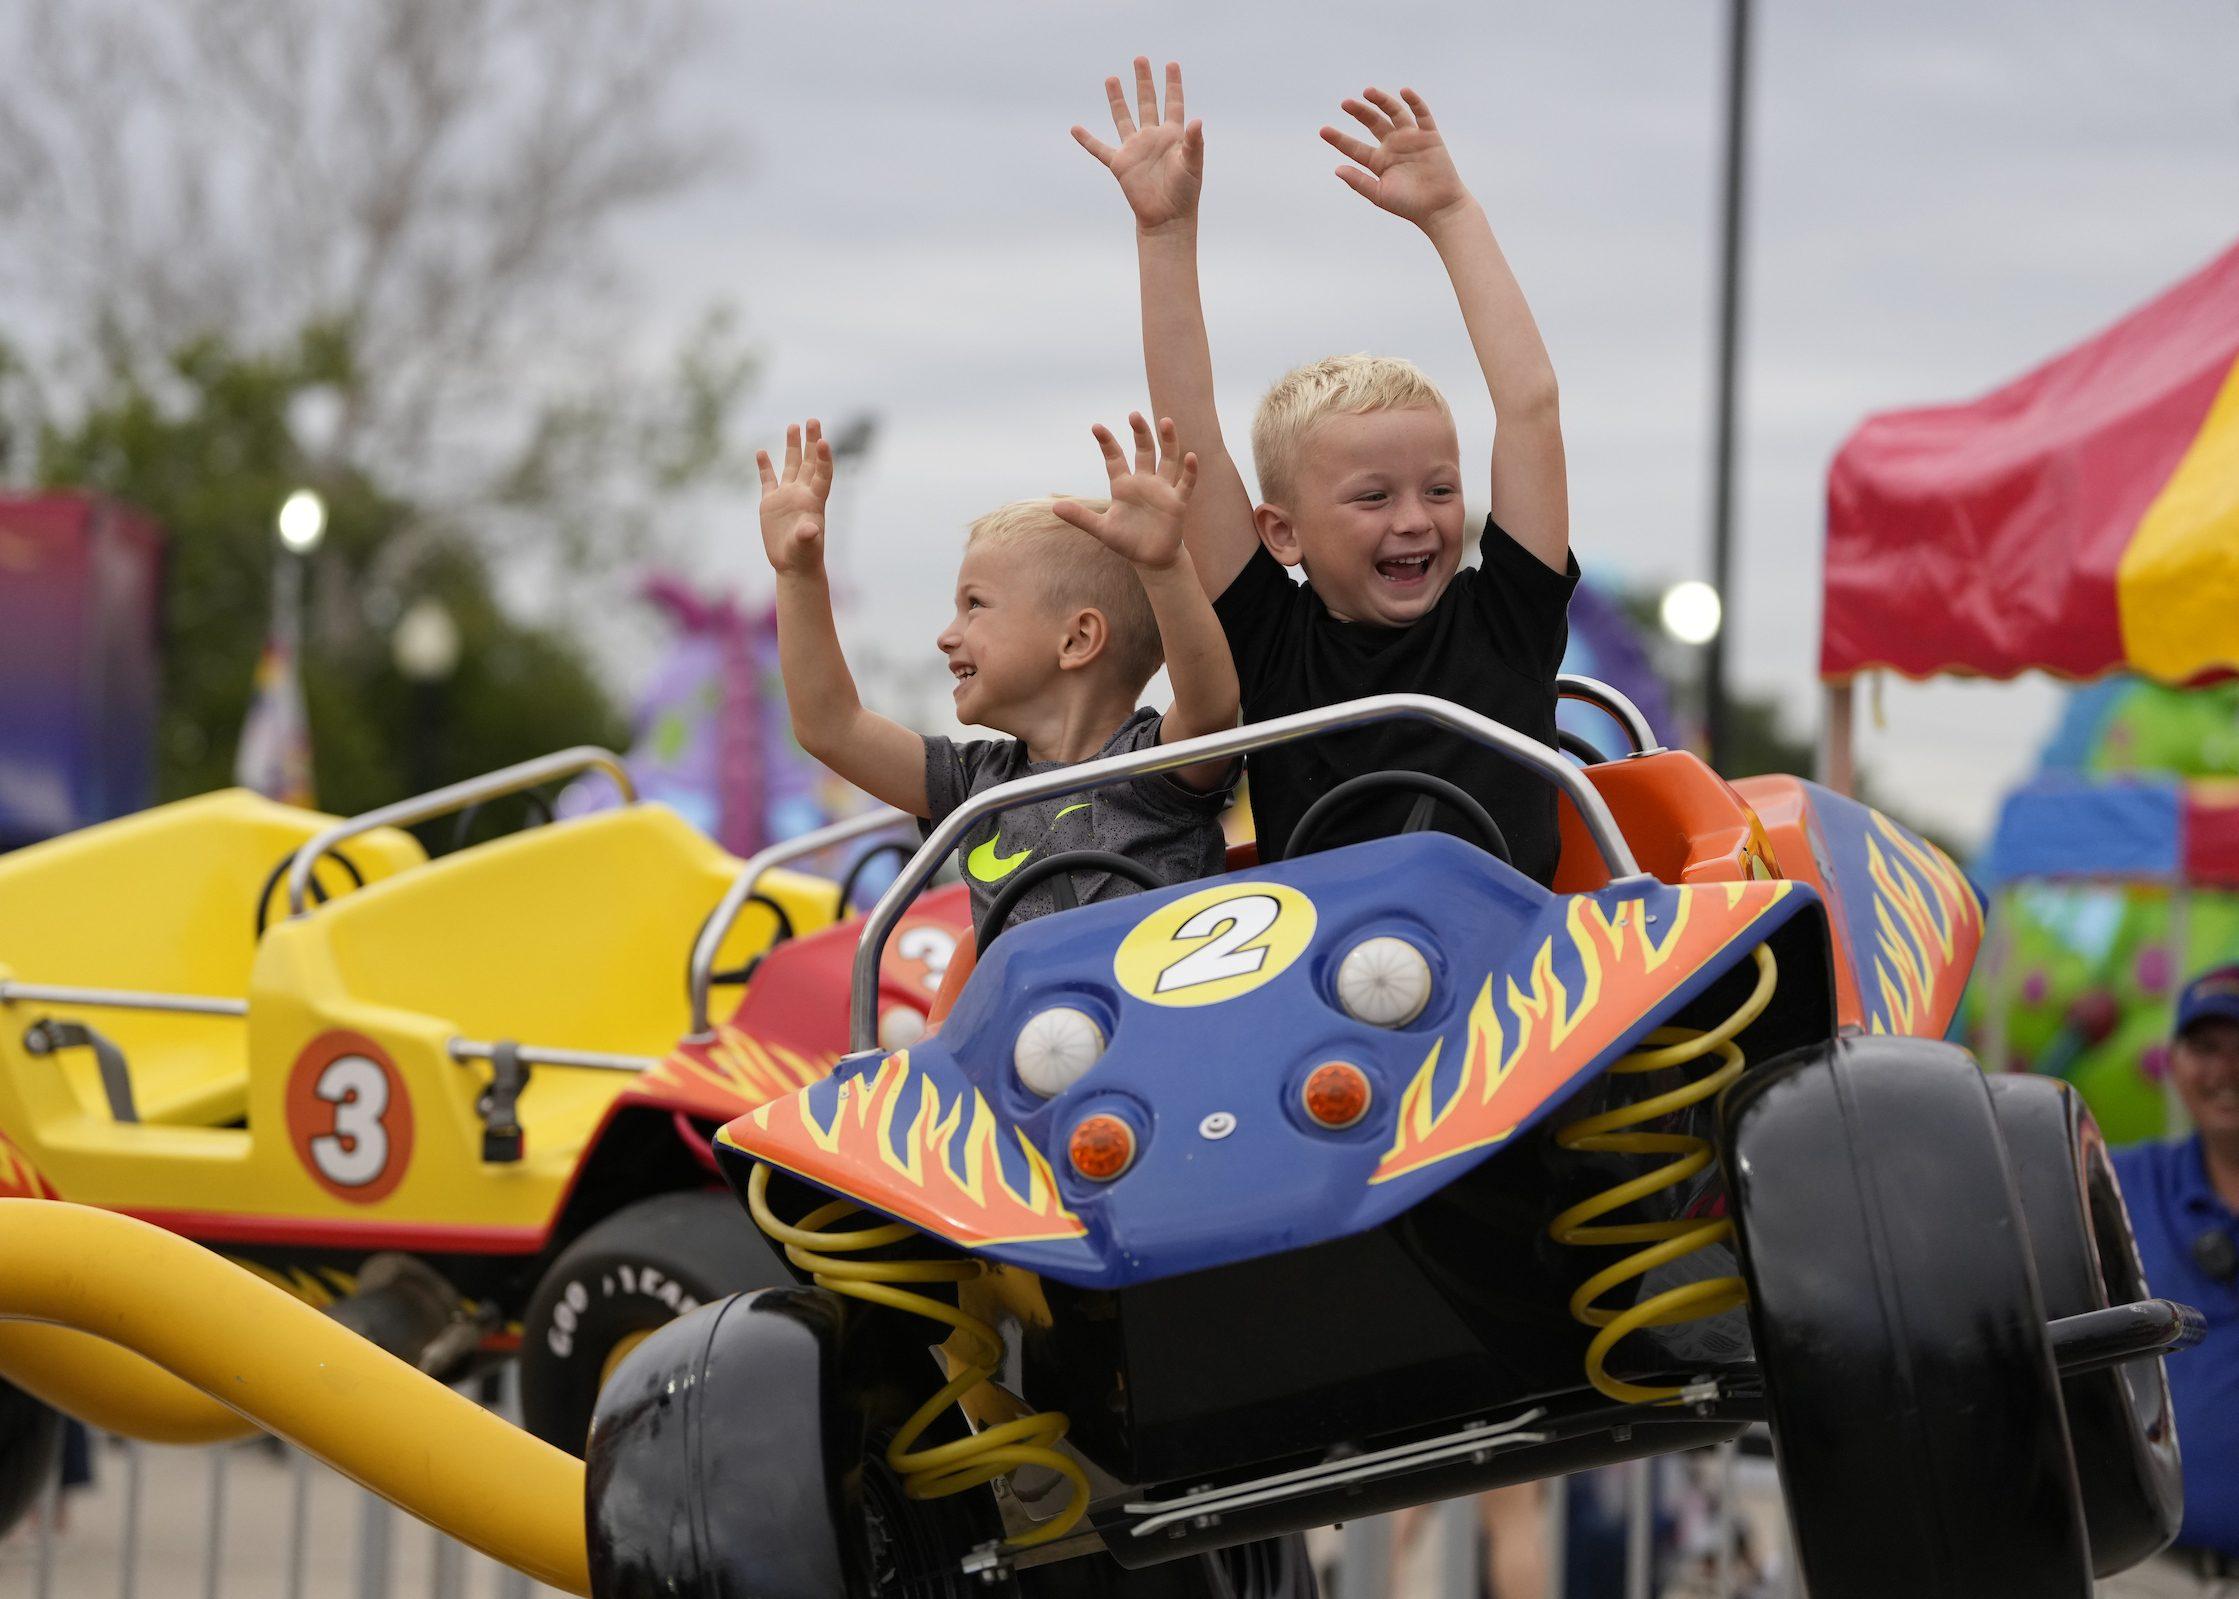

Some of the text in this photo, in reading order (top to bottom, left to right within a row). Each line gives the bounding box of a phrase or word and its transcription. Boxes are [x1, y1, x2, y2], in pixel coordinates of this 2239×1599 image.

[898, 926, 956, 992] 3
[1153, 895, 1281, 994] 2
[311, 1053, 390, 1188] 3
